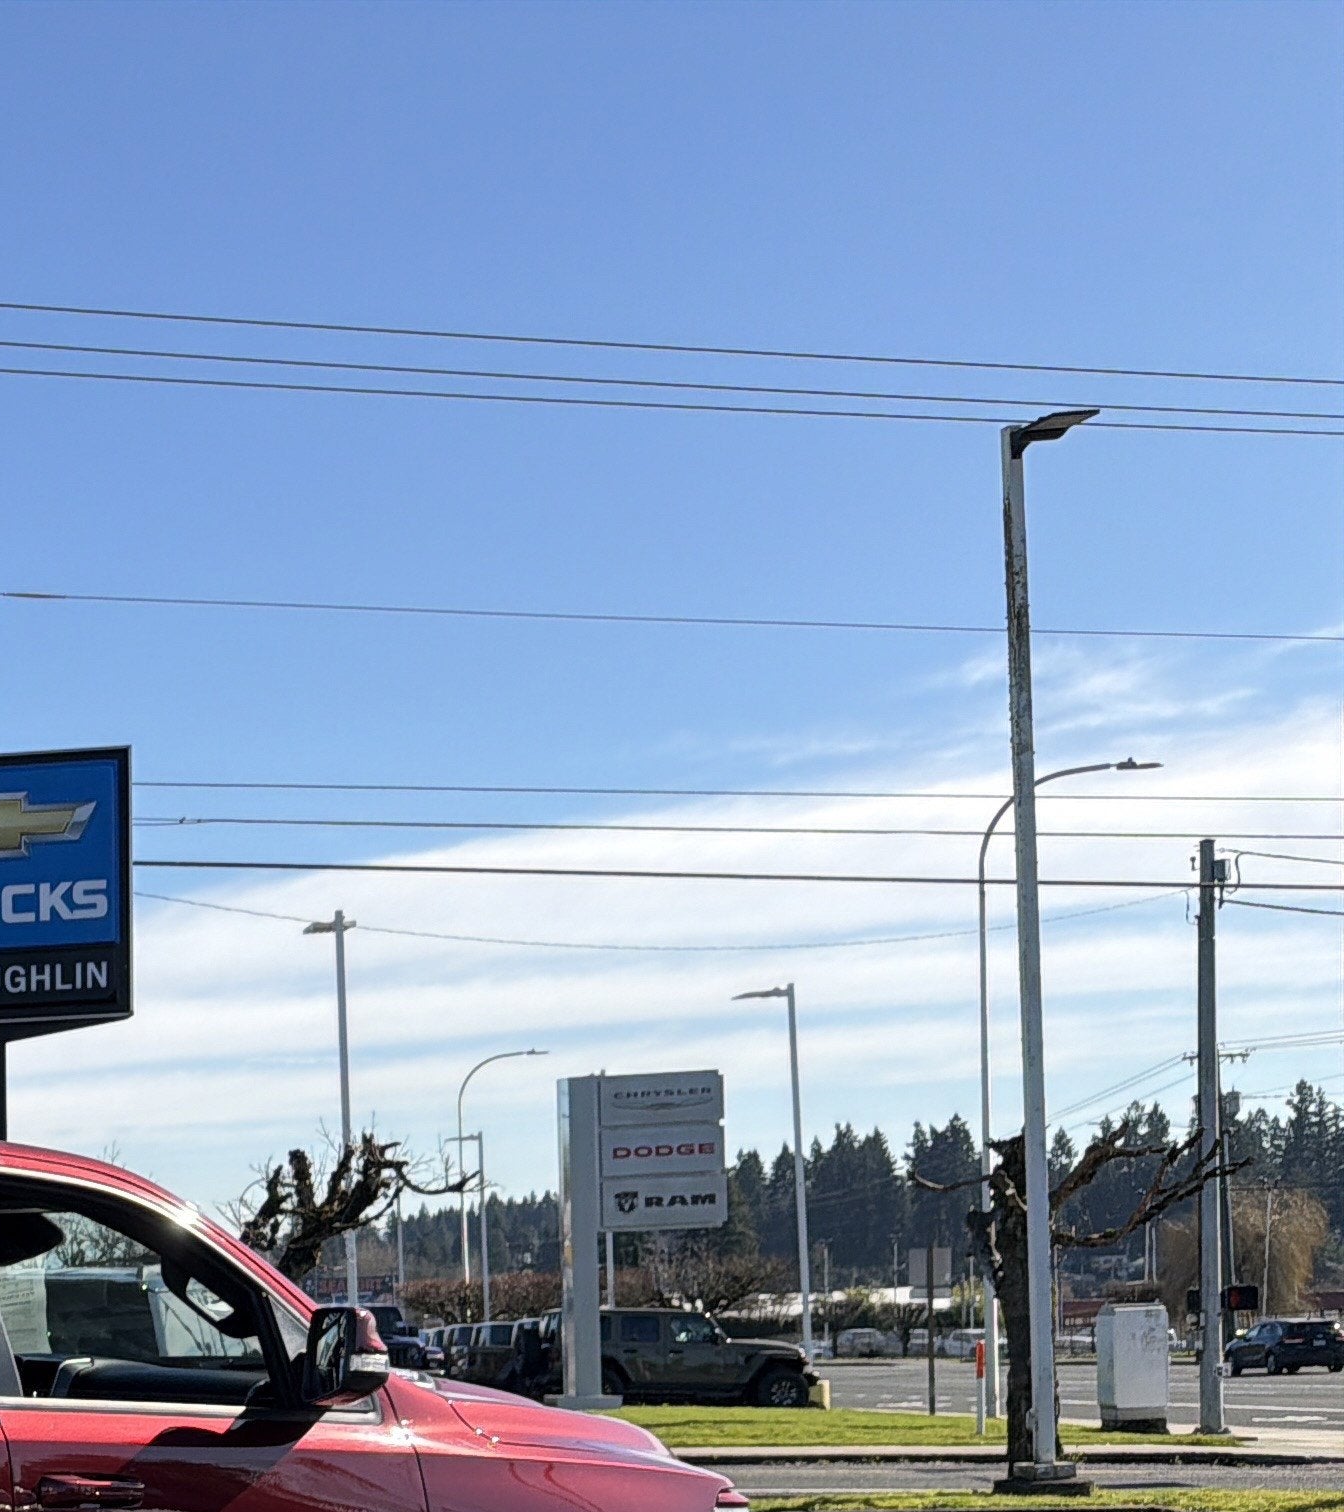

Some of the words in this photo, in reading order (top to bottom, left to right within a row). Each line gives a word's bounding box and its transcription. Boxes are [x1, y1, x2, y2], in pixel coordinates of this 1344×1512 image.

[613, 1087, 712, 1100] CHRYSLER
[612, 1142, 715, 1160] DODGE
[644, 1193, 717, 1208] RAM
